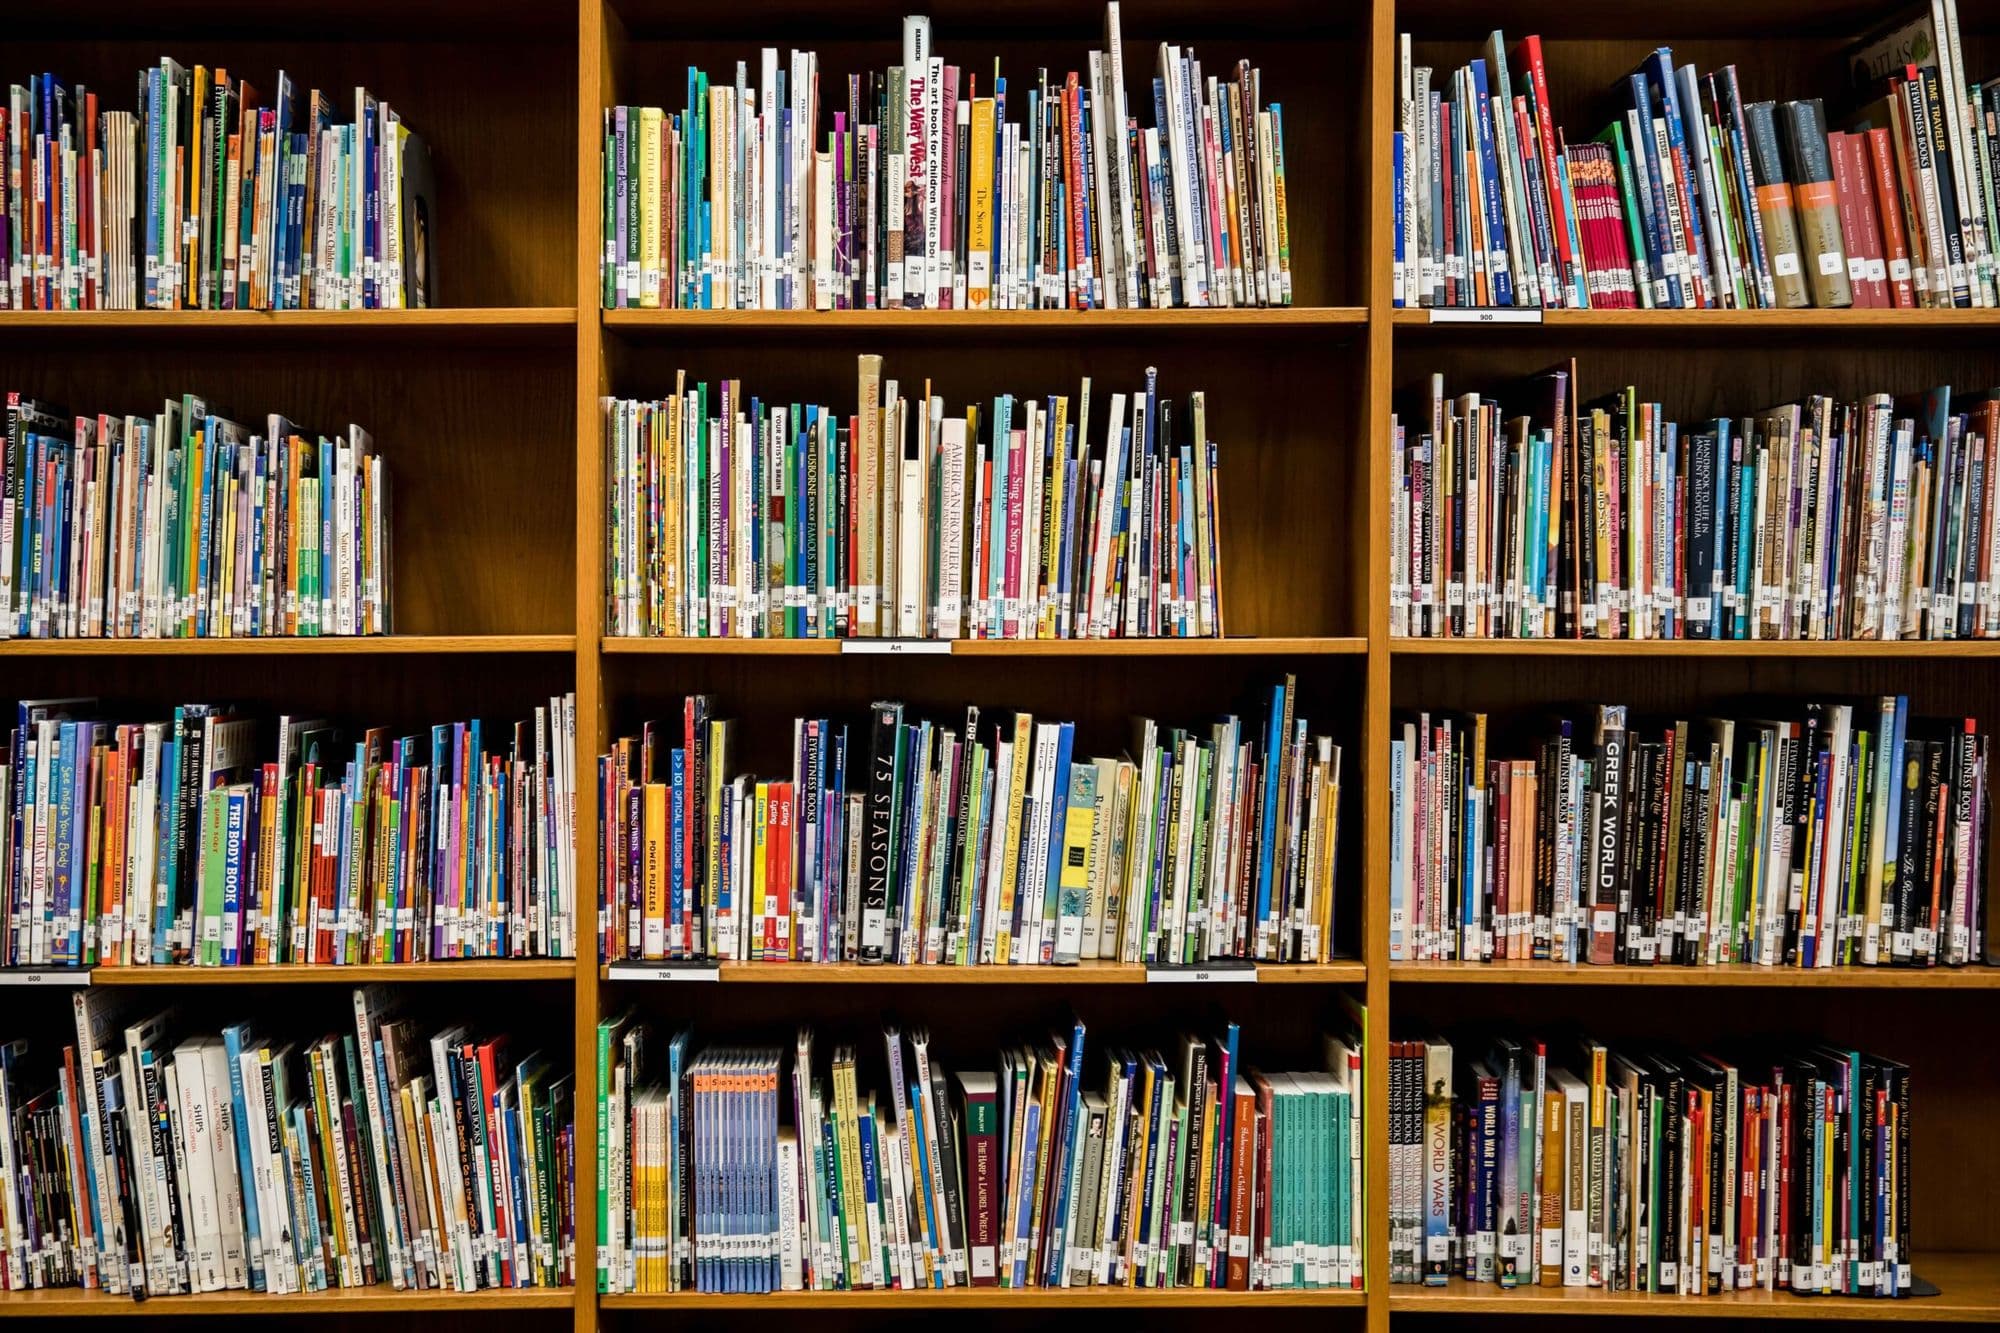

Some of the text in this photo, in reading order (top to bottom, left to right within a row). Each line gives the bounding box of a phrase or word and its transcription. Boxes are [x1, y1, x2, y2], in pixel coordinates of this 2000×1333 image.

[153, 109, 160, 118] OF
[907, 77, 924, 177] The Way West
[1431, 112, 1439, 150] Geography
[1928, 78, 1945, 151] TIME TRAVELER
[859, 135, 867, 185] MUSEUM
[929, 64, 939, 238] The art book for children White
[1182, 65, 1200, 214] MAGNIFICATIONS An Ancient Greek Temple
[1433, 152, 1440, 160] of
[151, 174, 159, 216] HEMISPHERE
[1657, 130, 1680, 232] LEVENSON WOMEN OF THE
[630, 193, 638, 225] Pharaoh's
[974, 187, 987, 247] The Story of
[630, 227, 638, 253] Kitchen
[839, 442, 847, 462] Robes
[866, 383, 877, 501] MASTERS of PAINTING
[1145, 454, 1153, 466] The
[3, 413, 16, 544] EYEWITNESS BOOKS ELEPHANT
[807, 454, 817, 496] USBORNE
[838, 474, 846, 505] Splendor
[1010, 477, 1022, 498] Sing
[1143, 468, 1153, 514] Star-Spangled
[1424, 466, 1432, 478] THE
[1701, 439, 1710, 533] HANDBOOK TO LIFE IN
[200, 494, 210, 561] HARP SEAL PUPS
[712, 472, 720, 584] NATURE CRAFTS for KIDS
[809, 513, 814, 521] OF
[948, 443, 963, 596] AMERICAN FRONTIER LIFE
[1011, 502, 1022, 517] Me
[1693, 478, 1702, 538] MESOPOTAMIA
[323, 520, 331, 555] COUGARS
[807, 523, 816, 560] FAMOUS
[1009, 528, 1021, 554] Story
[1413, 501, 1422, 590] EGYPTIAN TOMBS
[1423, 552, 1431, 581] WORLD
[674, 773, 682, 786] 101
[807, 738, 818, 822] EYEWITNESS BOOKS
[58, 766, 72, 867] See inside Your Body
[769, 800, 778, 824] Cycling
[781, 802, 790, 826] Cycling
[868, 756, 892, 906] 75 SEASONS
[958, 794, 969, 846] GLADIATORS
[1601, 742, 1619, 888] GREEK WORLD
[225, 804, 239, 903] THE BODY BOOK
[674, 827, 682, 868] ILLUSIONS
[1772, 816, 1783, 852] KNIGHT
[34, 826, 48, 891] HUMAN BODY
[357, 1014, 377, 1118] BIG BOOK OF AIRPLANES
[1194, 1055, 1205, 1111] Shakespeare's
[193, 1104, 203, 1133] SHIPS
[263, 1069, 279, 1151] EYEWITNESS BOOKS
[466, 1061, 482, 1143] EYEWITNESS BOOKS
[1414, 1059, 1423, 1142] EYEWITNESS BOOKS
[1485, 1105, 1495, 1135] WORLD
[1815, 1089, 1824, 1120] SPAIN
[1193, 1115, 1202, 1131] Life
[979, 1155, 988, 1174] HARP
[1190, 1151, 1199, 1178] Times
[1432, 1123, 1445, 1215] WORLD WARS
[1485, 1139, 1495, 1158] WAR
[302, 1158, 313, 1194] FLUSH!
[491, 1160, 503, 1207] ROBOTS
[538, 1170, 547, 1217] SUGARING
[979, 1183, 988, 1210] LAUREL
[1726, 1169, 1735, 1207] Germany
[979, 1212, 988, 1242] WREATH
